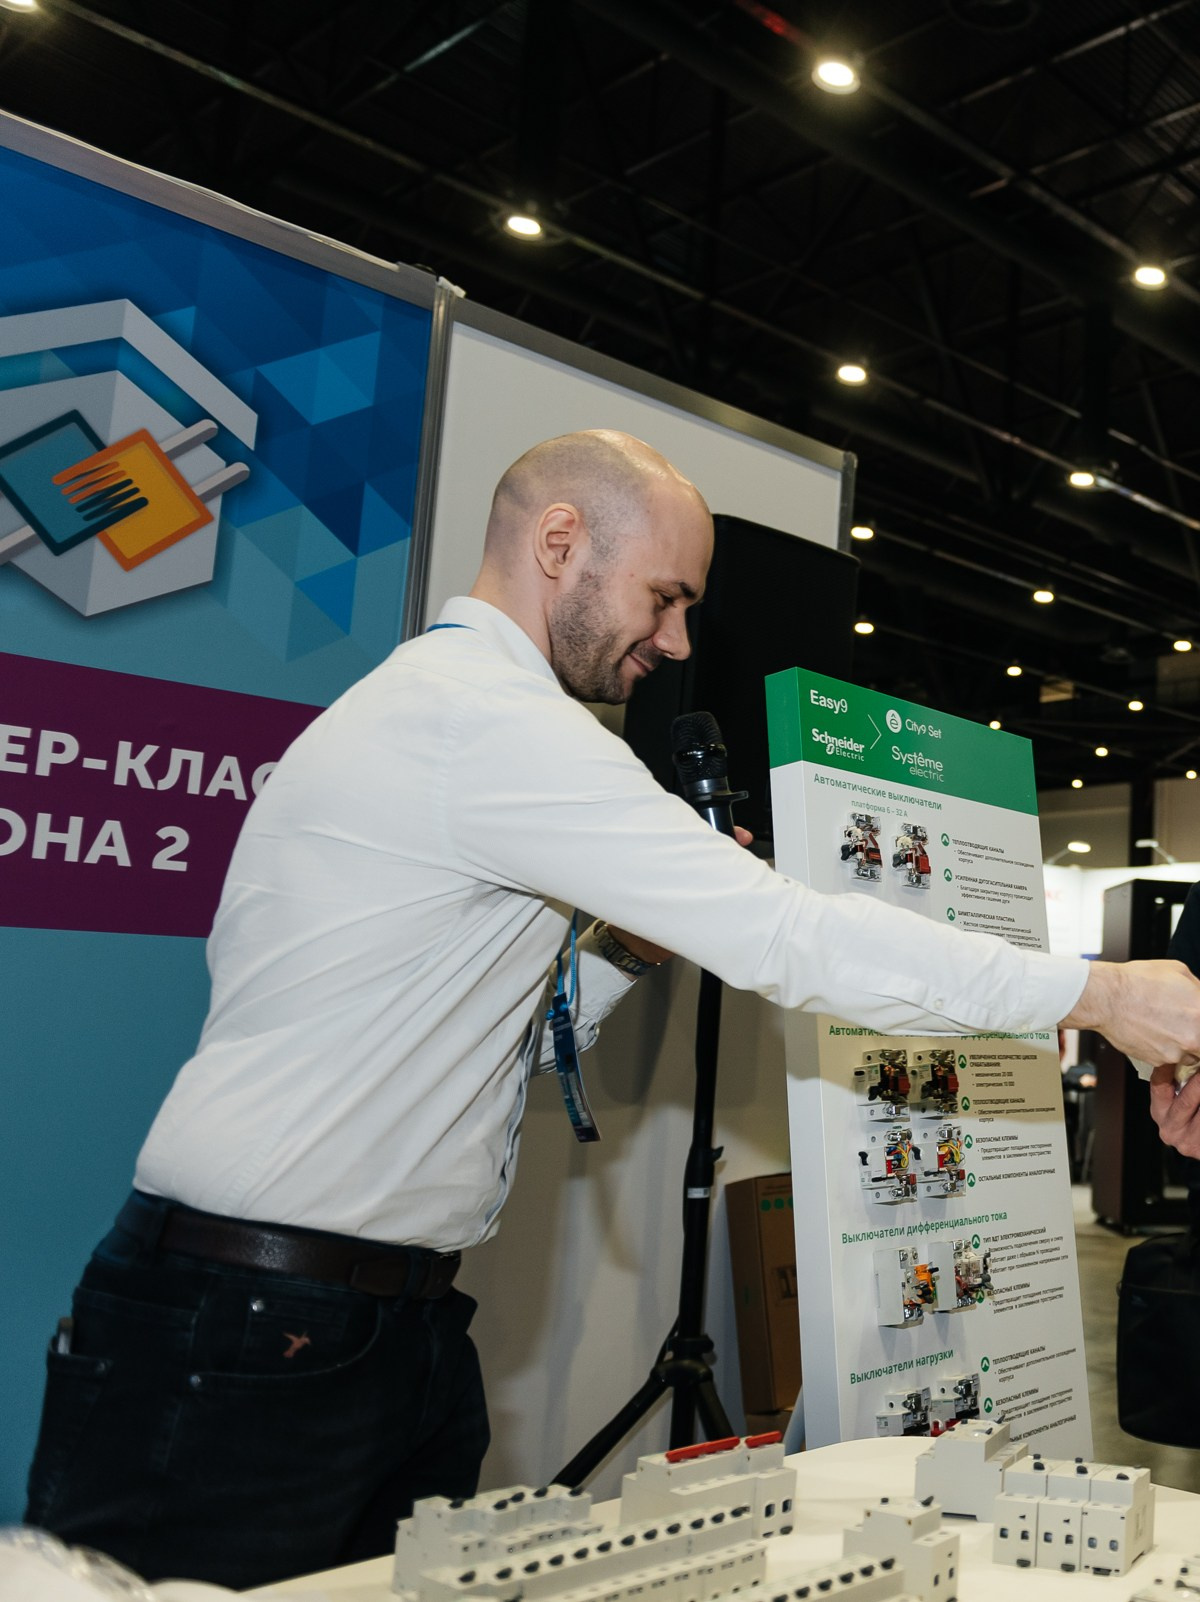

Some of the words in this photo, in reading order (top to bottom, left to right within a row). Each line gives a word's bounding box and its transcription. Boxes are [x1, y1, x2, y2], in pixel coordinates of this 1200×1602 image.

[810, 689, 848, 714] Easy9
[812, 728, 864, 753] Schneider
[906, 719, 926, 735] City9
[928, 725, 942, 738] Set
[836, 749, 864, 761] Electric
[910, 766, 944, 782] electric
[814, 773, 886, 798] Автоматические
[888, 791, 942, 810] выключатели
[852, 801, 885, 812] платформа
[152, 825, 190, 872] 2
[842, 1226, 905, 1244] Выключатели
[907, 1214, 990, 1237] дифференциального
[991, 1211, 1008, 1221] тока
[850, 1360, 914, 1384] Выключатели
[916, 1349, 954, 1366] нагрузки
